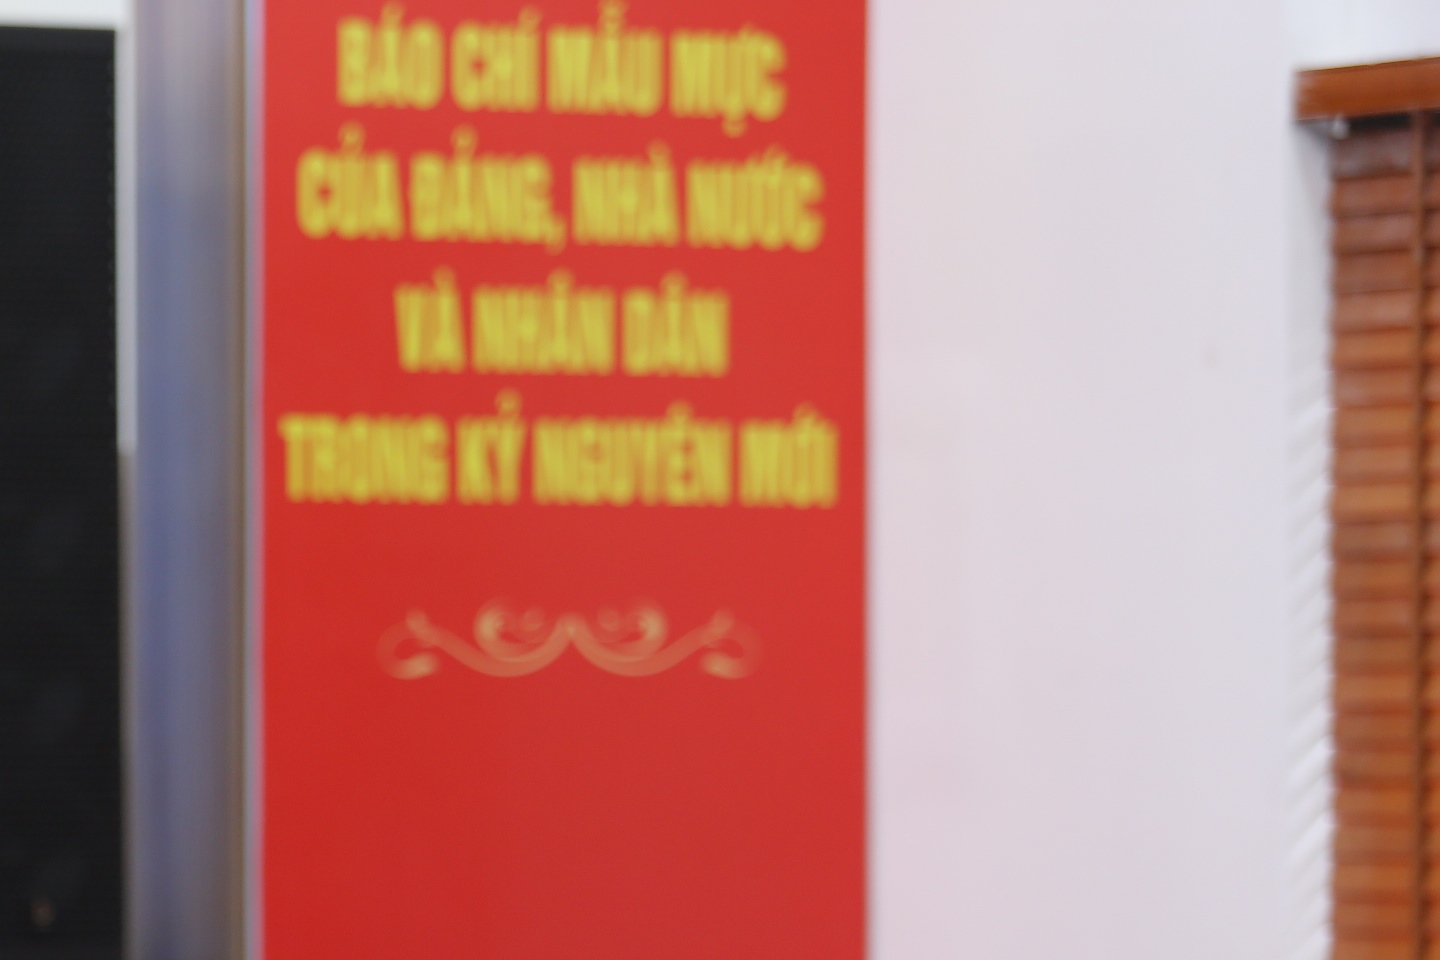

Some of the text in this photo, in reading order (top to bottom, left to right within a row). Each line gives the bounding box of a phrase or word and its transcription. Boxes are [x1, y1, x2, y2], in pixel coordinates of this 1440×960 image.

[337, 4, 444, 107] BÁO
[450, 6, 540, 111] CHÍ
[670, 26, 785, 136] MỰC
[296, 122, 404, 239] CỦA
[572, 140, 680, 246] NHÀ
[685, 145, 823, 251] NƯỚC
[394, 268, 729, 376] VÀ NHÂN DÂN
[279, 413, 449, 503] TRONG
[533, 401, 732, 506] NGUYÊN
[738, 403, 838, 508] MỚI
